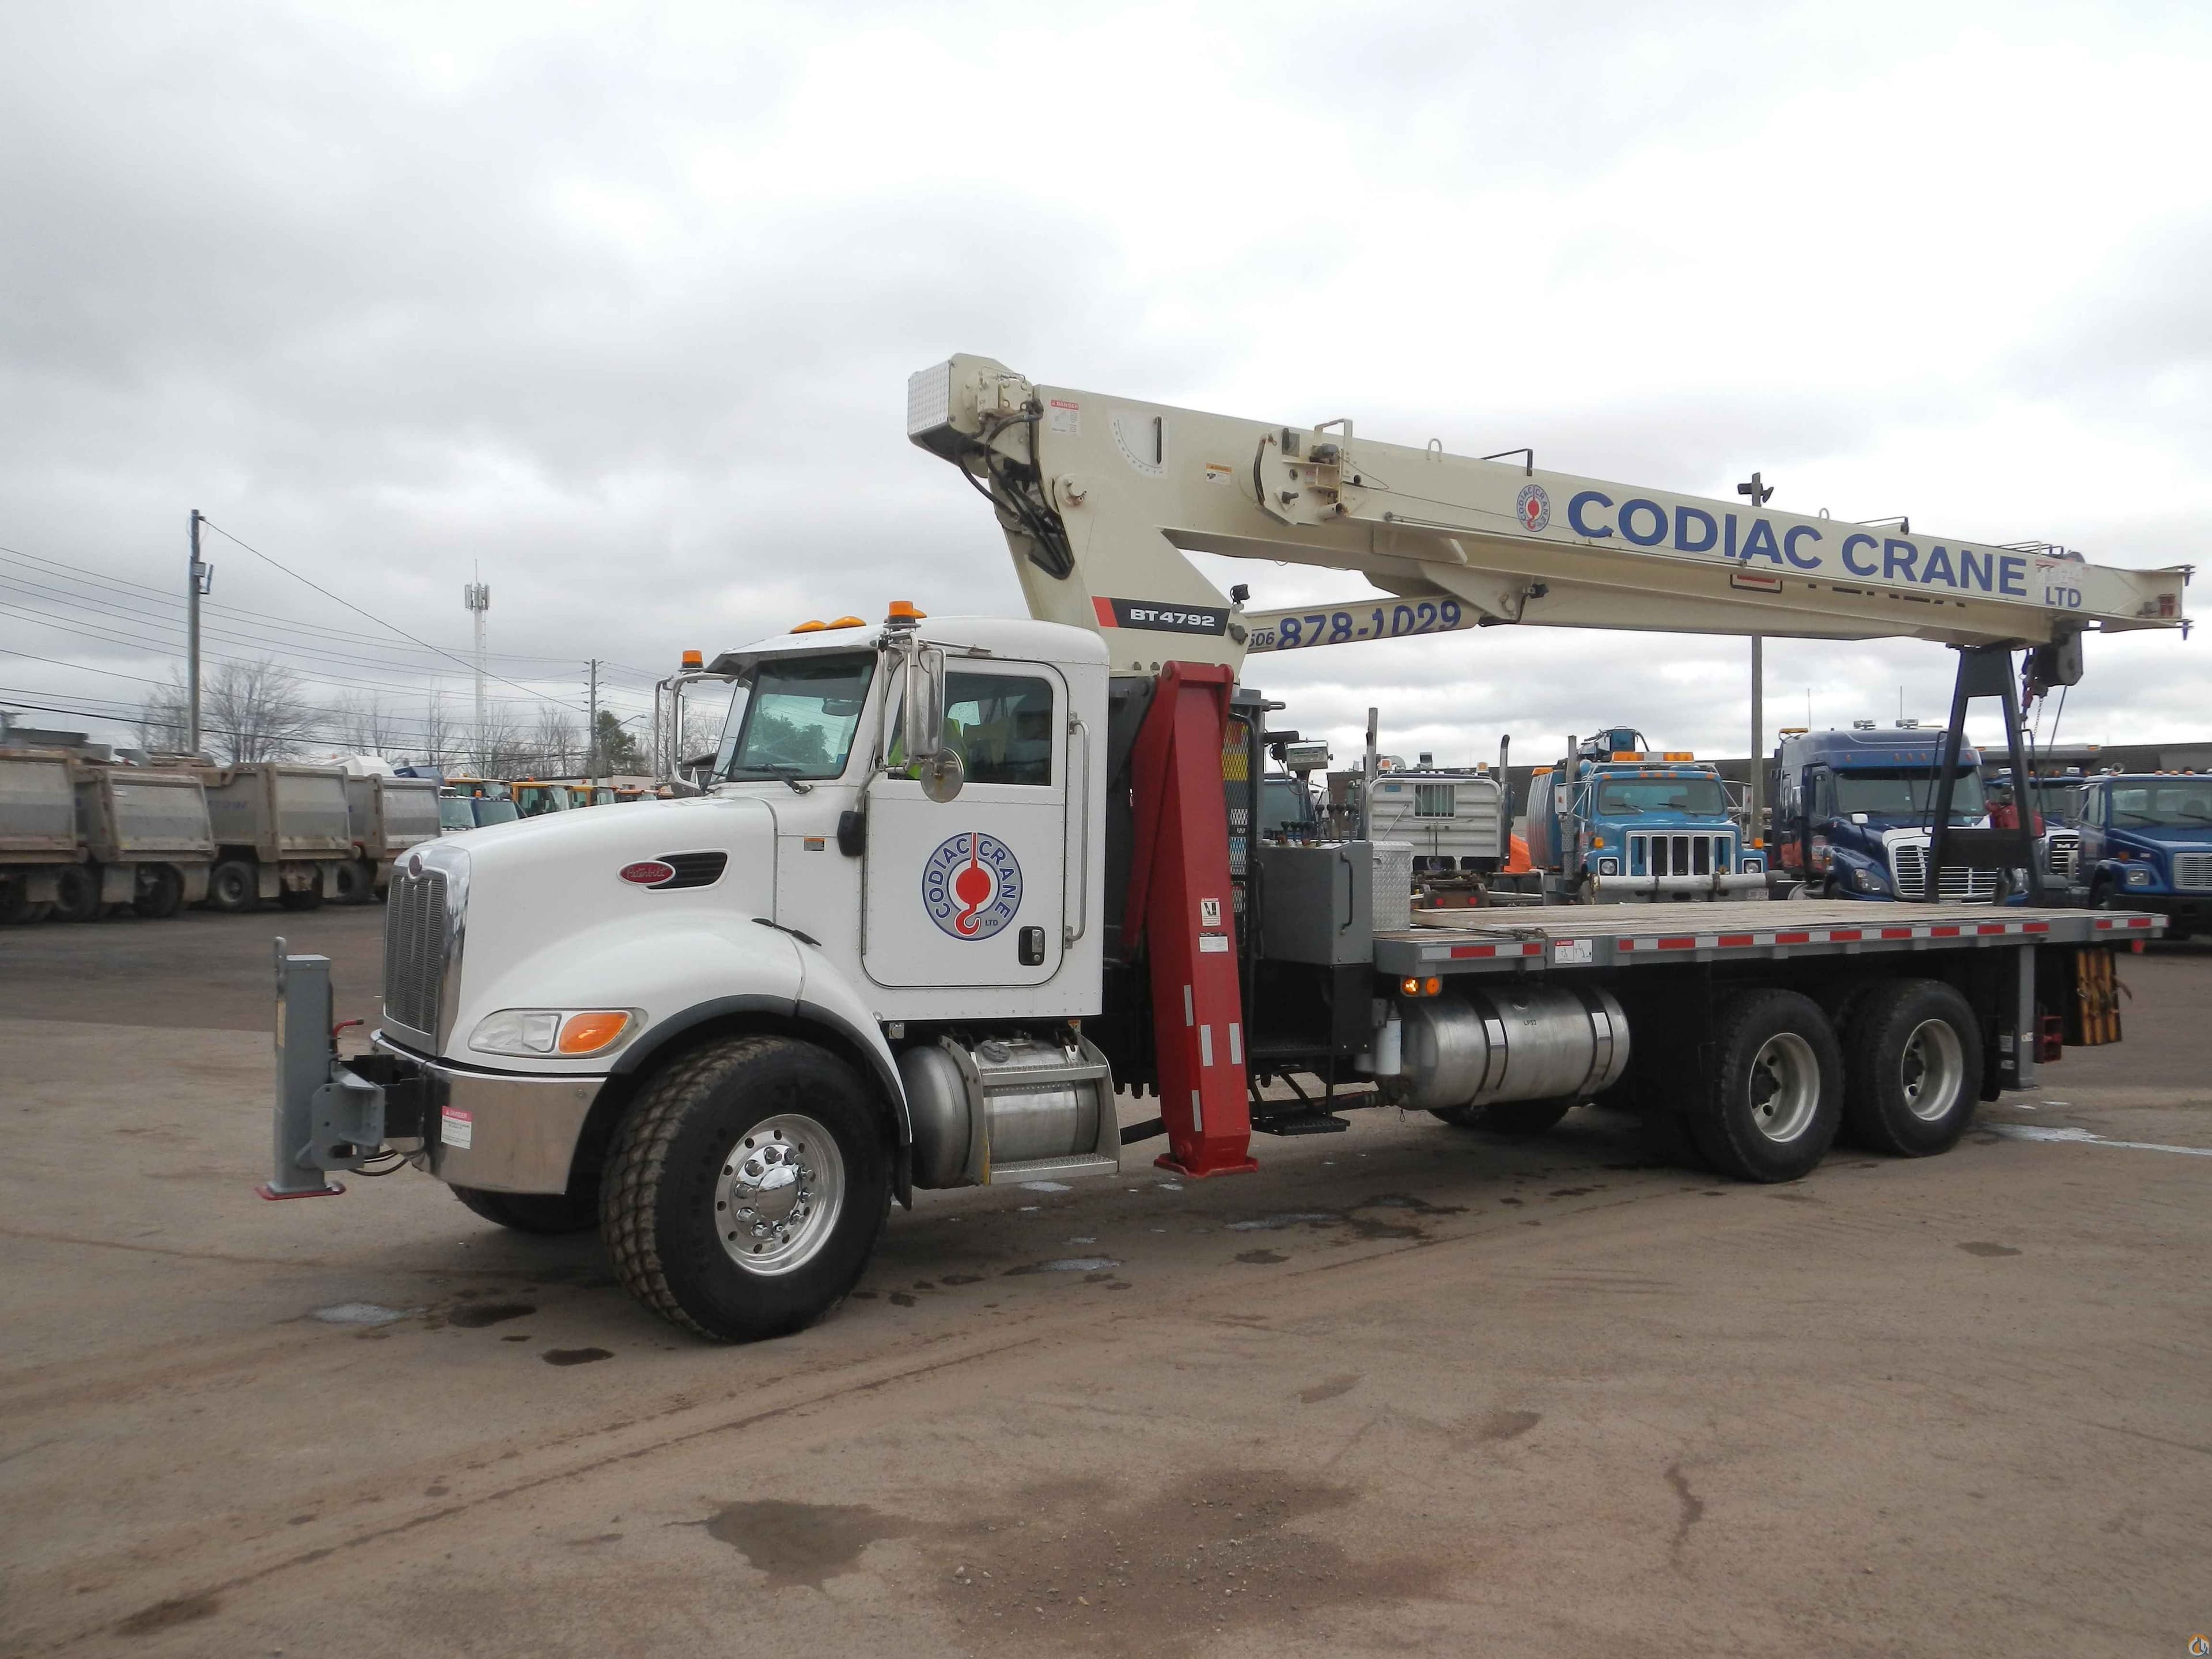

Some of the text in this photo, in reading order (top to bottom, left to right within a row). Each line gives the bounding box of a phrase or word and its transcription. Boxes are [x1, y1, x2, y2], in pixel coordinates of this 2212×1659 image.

[1518, 486, 1549, 524] CODIAC CRANE
[1567, 491, 2027, 596] CODIAC CRANE
[1130, 608, 1215, 627] BT4792
[2045, 586, 2081, 608] LTD
[1276, 600, 1461, 650] 878-1029
[928, 838, 1016, 918] CODIAC CRANE
